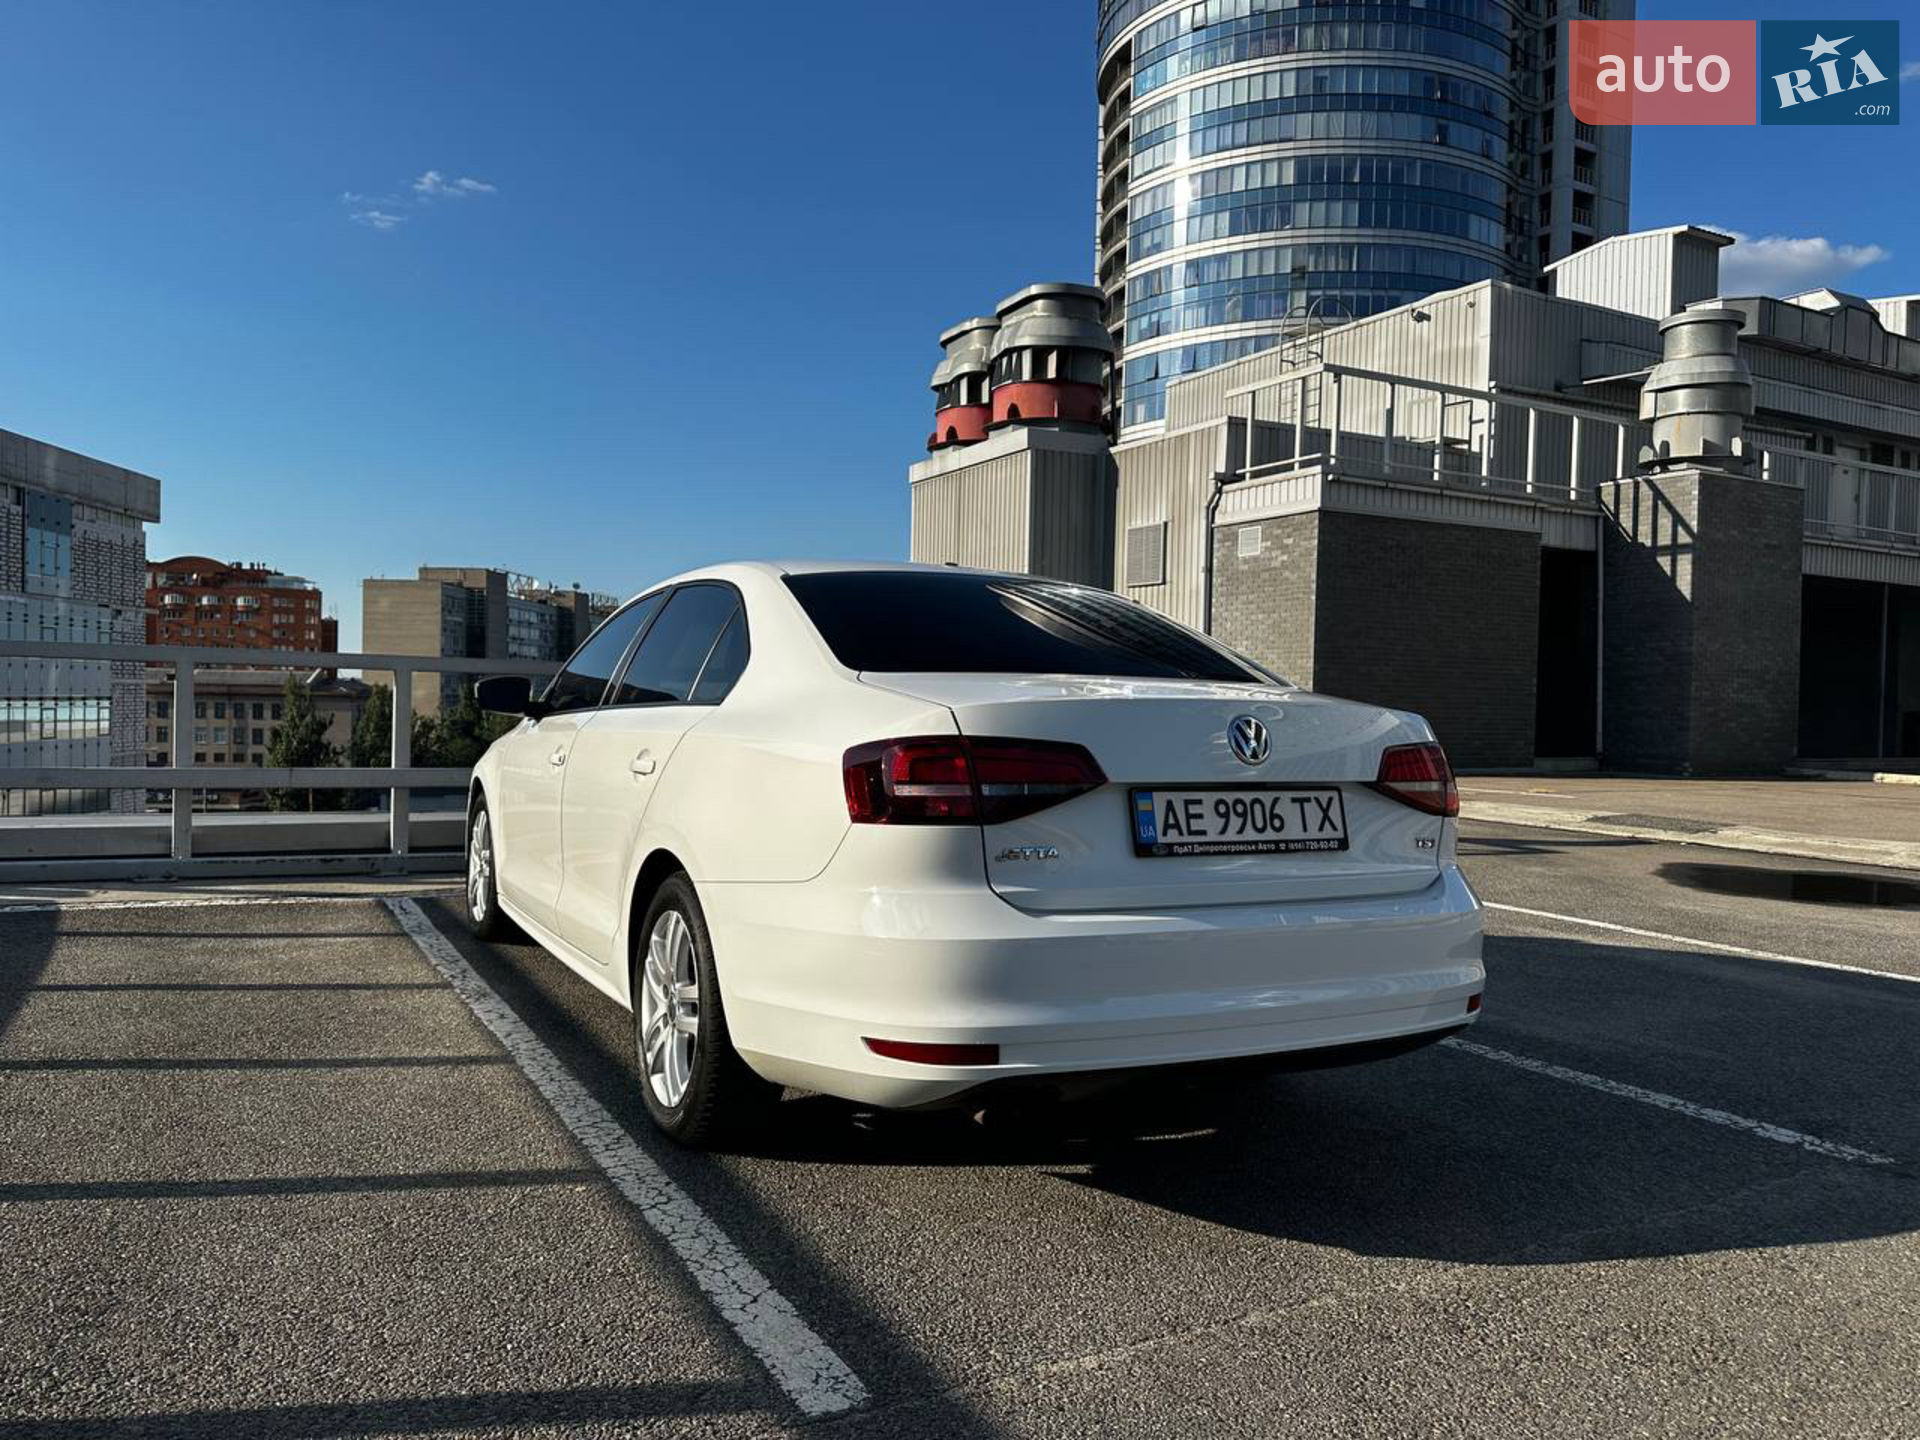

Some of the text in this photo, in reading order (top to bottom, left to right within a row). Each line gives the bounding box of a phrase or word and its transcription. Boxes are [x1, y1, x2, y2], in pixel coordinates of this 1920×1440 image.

[1162, 796, 1338, 838] AE 9906 TX
[1139, 825, 1156, 838] UA
